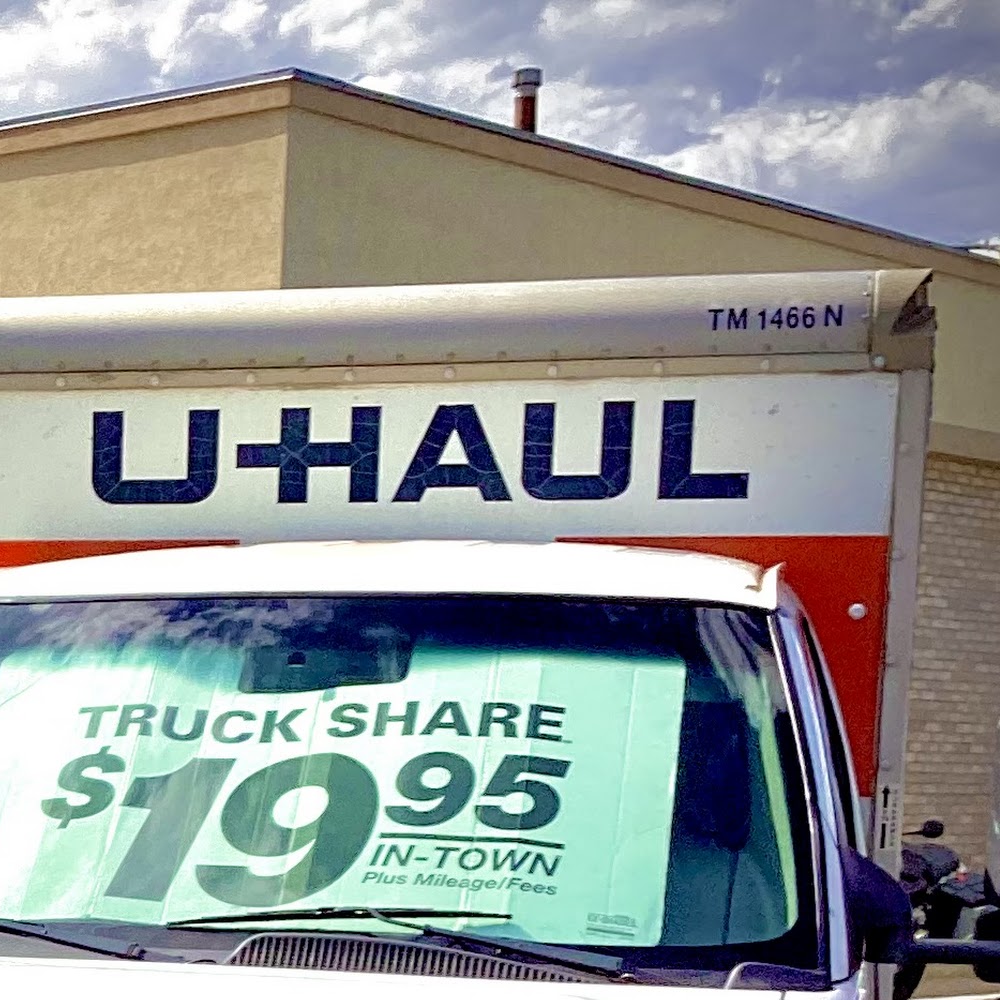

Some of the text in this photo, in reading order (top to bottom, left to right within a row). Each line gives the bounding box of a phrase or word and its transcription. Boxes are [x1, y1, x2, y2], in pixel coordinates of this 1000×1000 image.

[708, 304, 844, 331] TM 1466 N
[93, 400, 749, 504] U-HAUL
[78, 700, 567, 744] TRUCK SHARE
[369, 843, 563, 877] IN-TOWN
[361, 871, 558, 896] Plus Mileage/Fees
